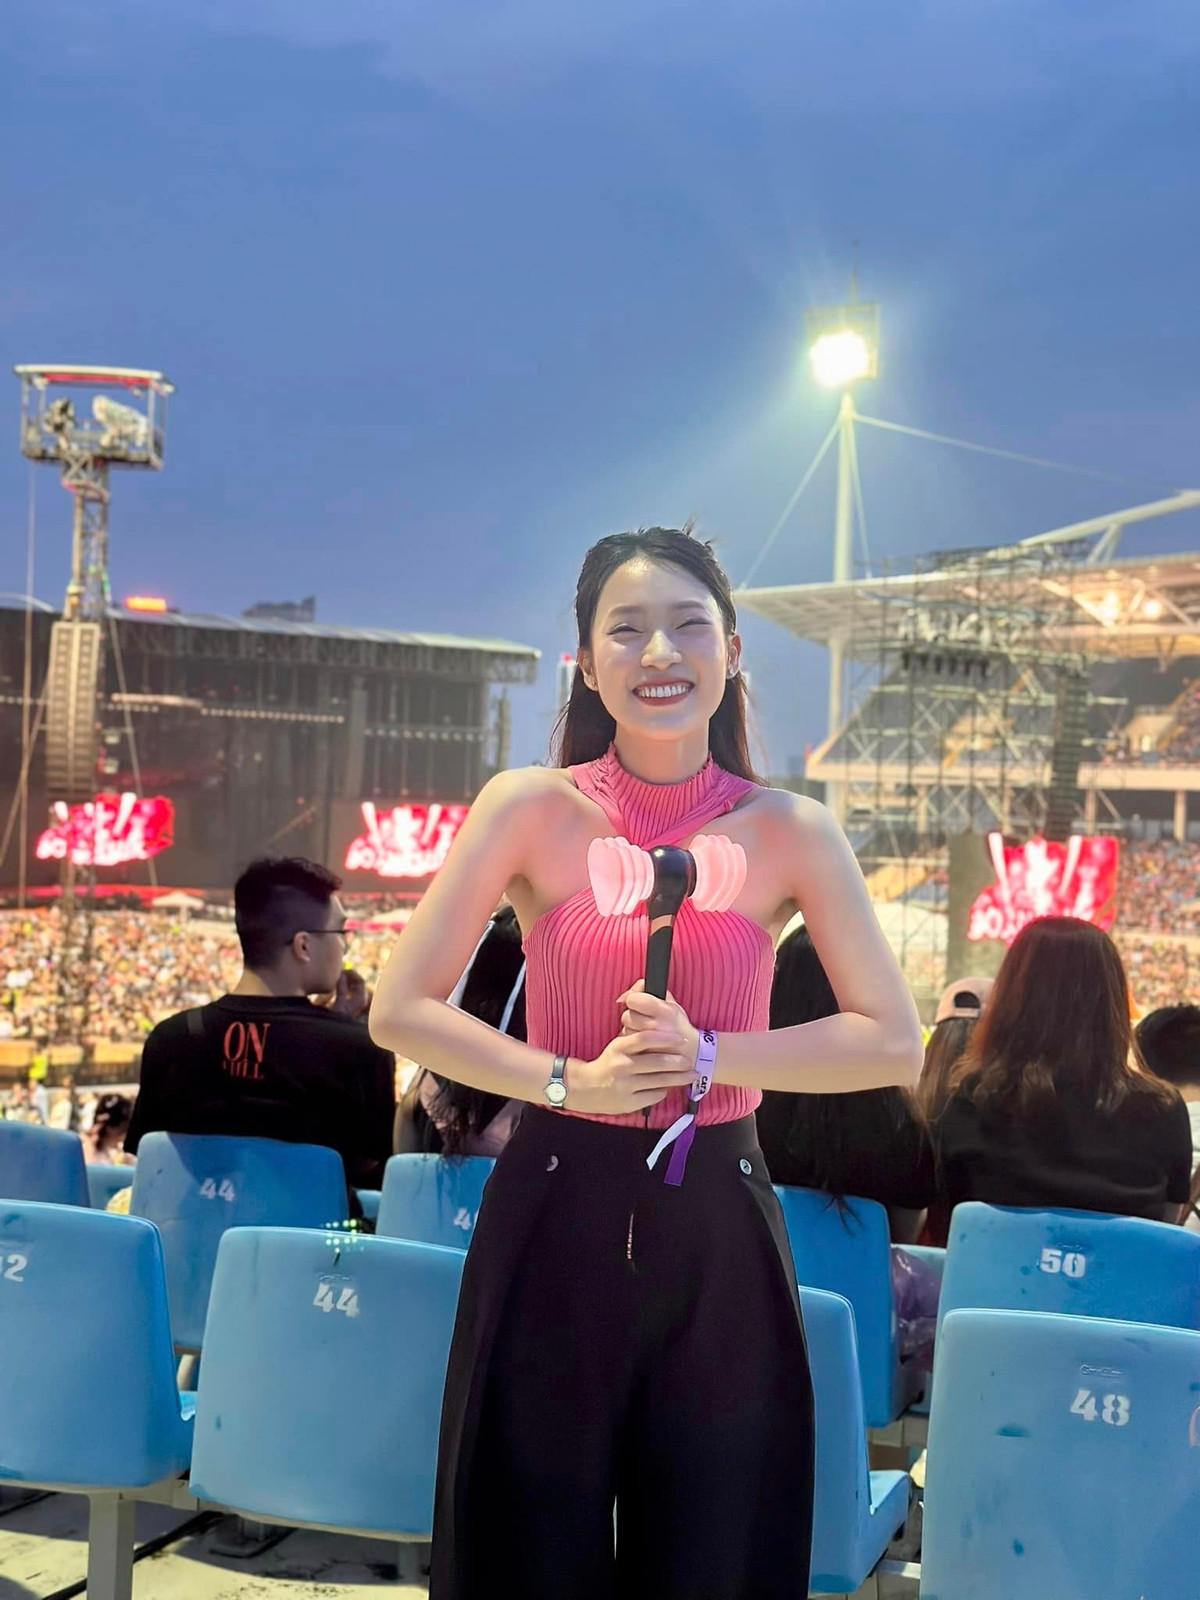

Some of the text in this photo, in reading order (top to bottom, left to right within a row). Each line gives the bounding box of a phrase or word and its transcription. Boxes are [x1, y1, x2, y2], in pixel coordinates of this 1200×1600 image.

[224, 1021, 271, 1063] ON
[200, 1177, 236, 1202] 44
[453, 1207, 479, 1230] 4
[0, 1254, 27, 1282] 2
[1040, 1248, 1086, 1277] 50
[312, 1282, 360, 1317] 44
[1070, 1388, 1130, 1426] 48
